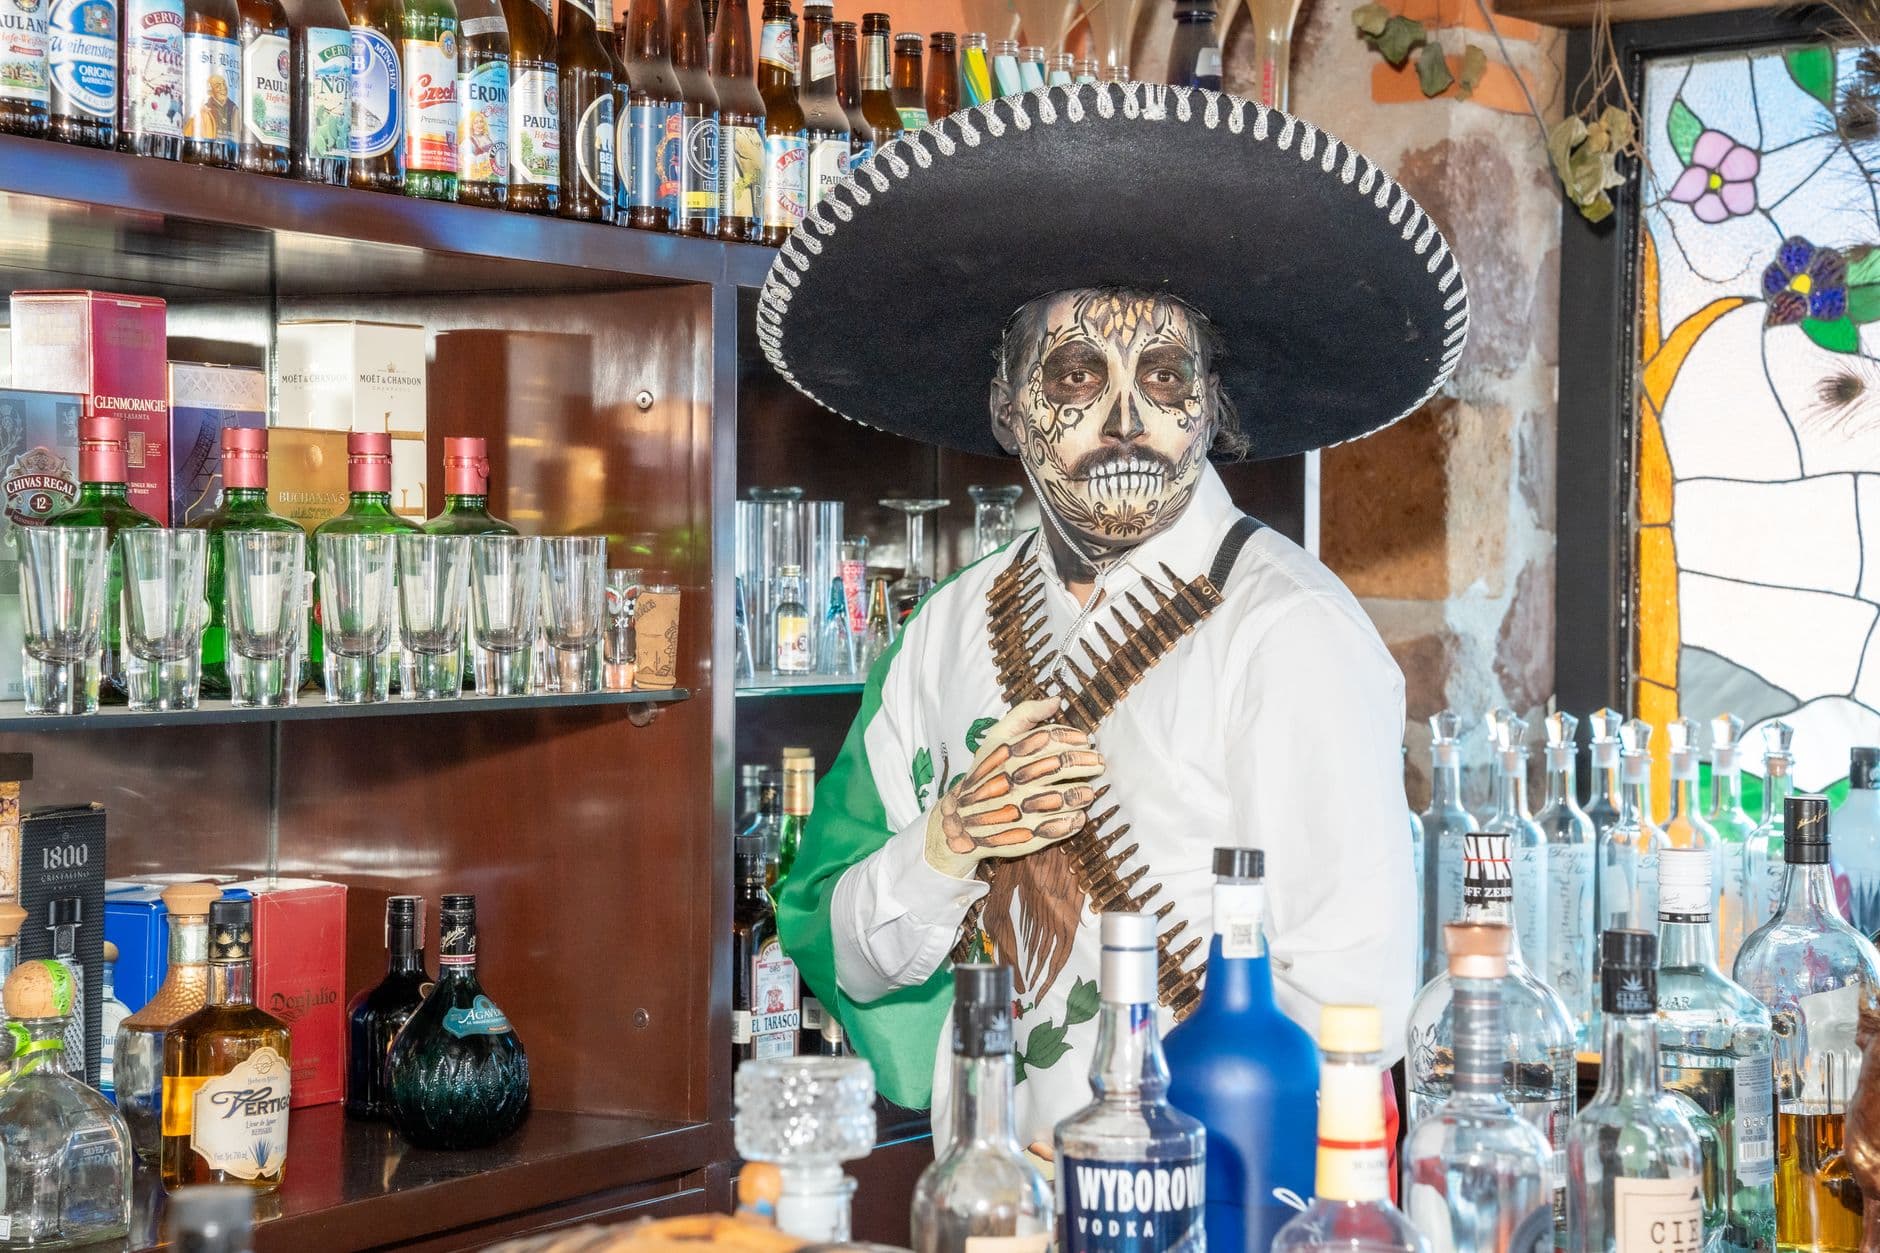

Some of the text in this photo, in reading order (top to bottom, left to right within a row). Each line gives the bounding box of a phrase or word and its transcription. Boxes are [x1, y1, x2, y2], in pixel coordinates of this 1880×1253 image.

[387, 376, 422, 386] CHANDON
[94, 395, 166, 412] GLENMORANGIE
[6, 476, 74, 495] CHIVAS REGAL
[36, 496, 47, 510] 12
[42, 843, 88, 869] 1800
[41, 871, 90, 883] CRISTALINO
[752, 1019, 760, 1033] EL
[764, 1012, 799, 1030] TARASCO
[1078, 1216, 1154, 1238] VODKA
